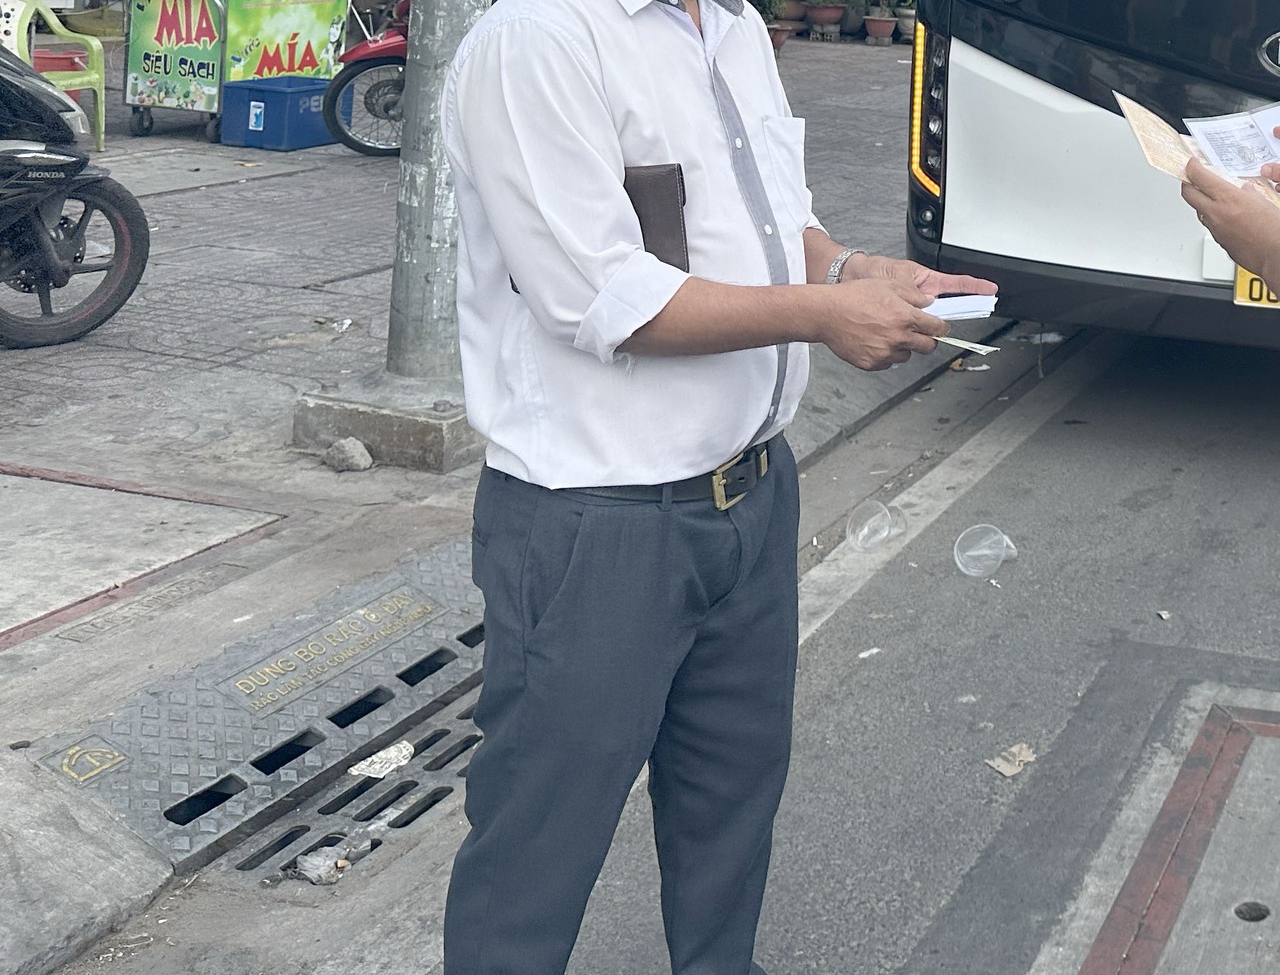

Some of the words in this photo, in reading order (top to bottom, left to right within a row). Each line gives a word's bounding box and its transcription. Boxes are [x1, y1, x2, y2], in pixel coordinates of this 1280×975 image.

[254, 31, 320, 76] MÍA
[178, 57, 216, 83] SẠCH
[28, 171, 66, 179] HONDA
